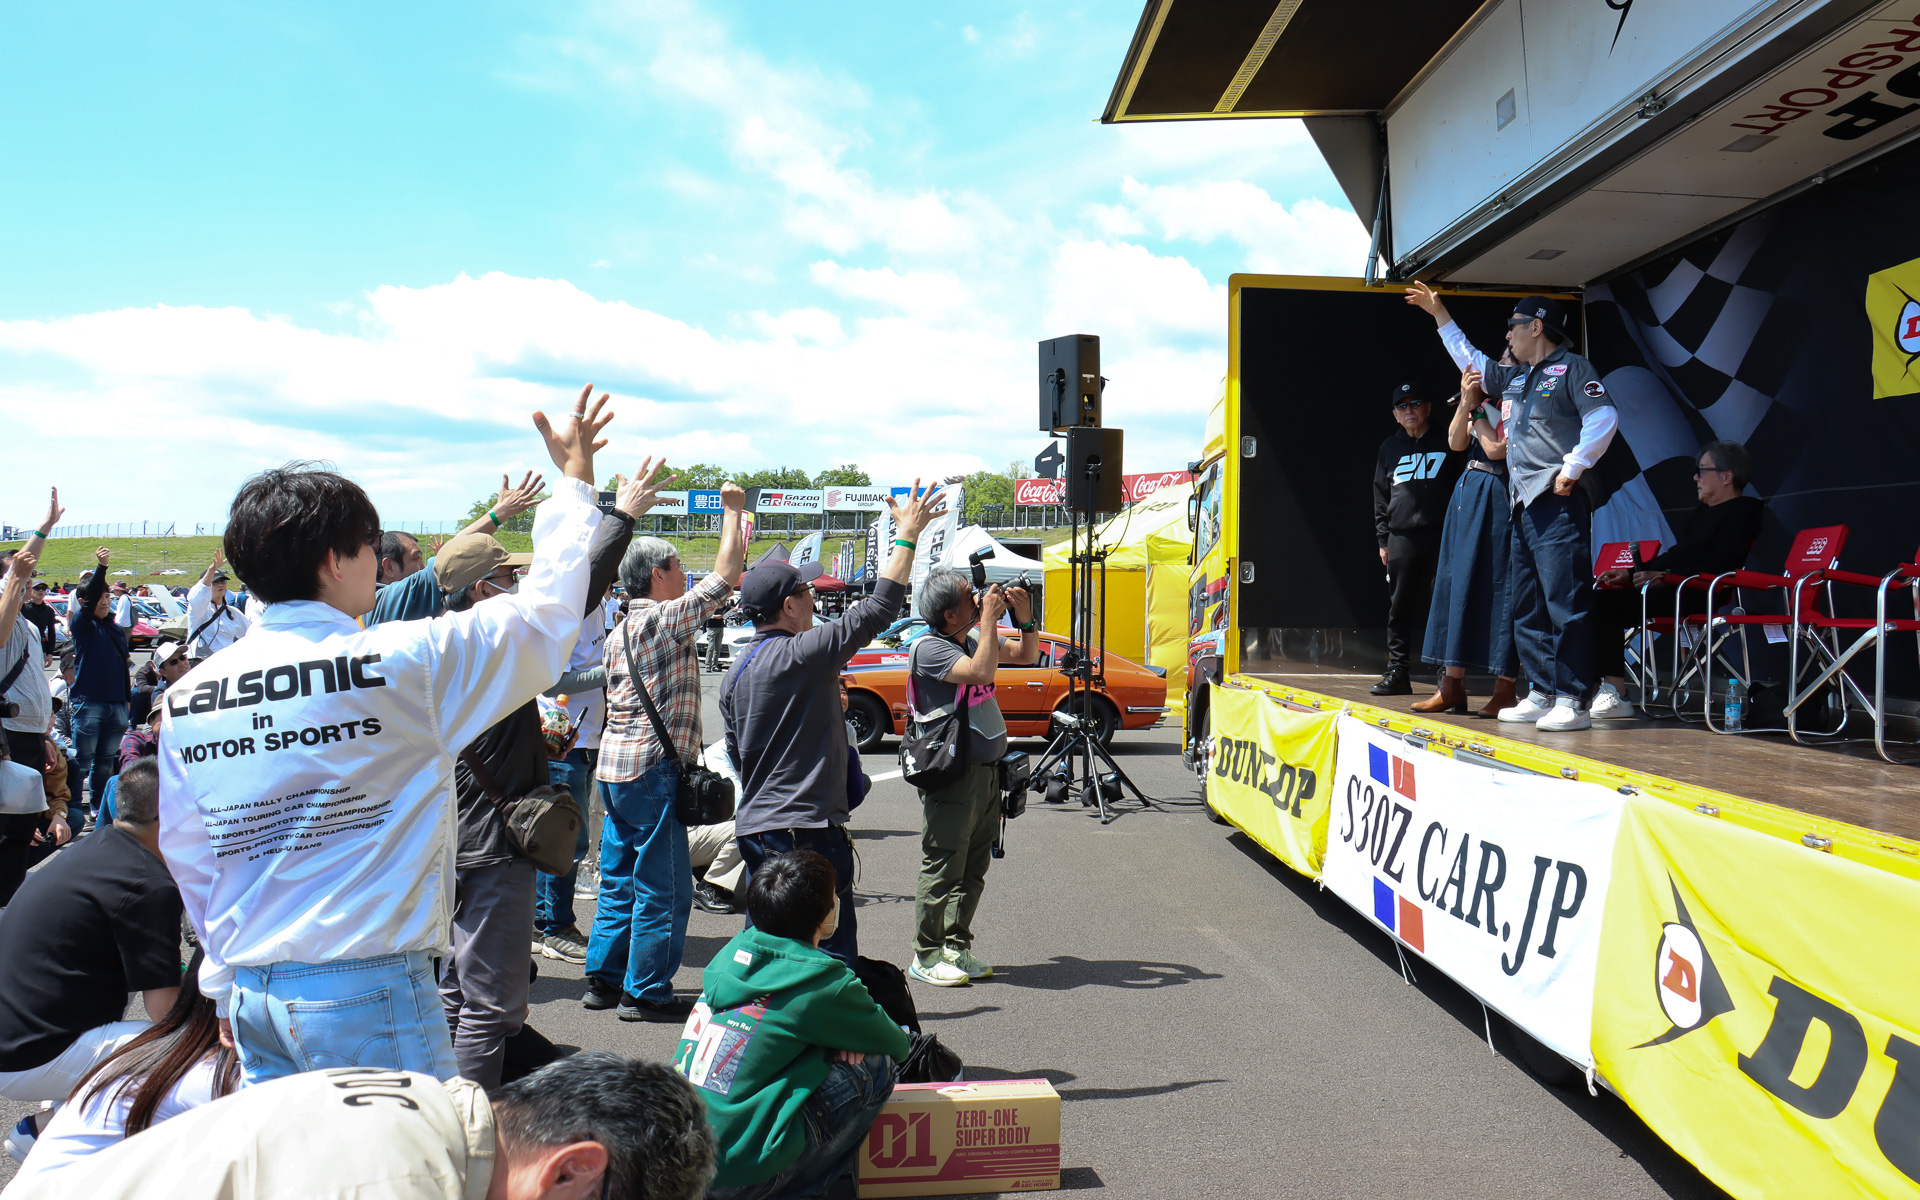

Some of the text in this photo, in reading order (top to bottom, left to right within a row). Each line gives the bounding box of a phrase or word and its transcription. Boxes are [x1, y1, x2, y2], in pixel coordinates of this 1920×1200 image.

[1730, 13, 1920, 135] RSPORT
[693, 494, 724, 509] 豊田
[783, 500, 818, 508] Racing
[252, 712, 273, 730] in
[180, 717, 382, 765] MOTOR SPORTS
[1216, 736, 1316, 819] DUNLOP
[254, 797, 283, 808] RALLY
[242, 809, 281, 823] TOURING
[284, 803, 304, 812] CAR
[248, 854, 260, 862] 24
[294, 841, 323, 852] MANS
[1340, 774, 1588, 976] S30Z CAR.JP
[956, 1108, 1019, 1128] ZERO-ONE
[869, 1112, 938, 1169] 01
[956, 1127, 1031, 1147] SUPER BODY
